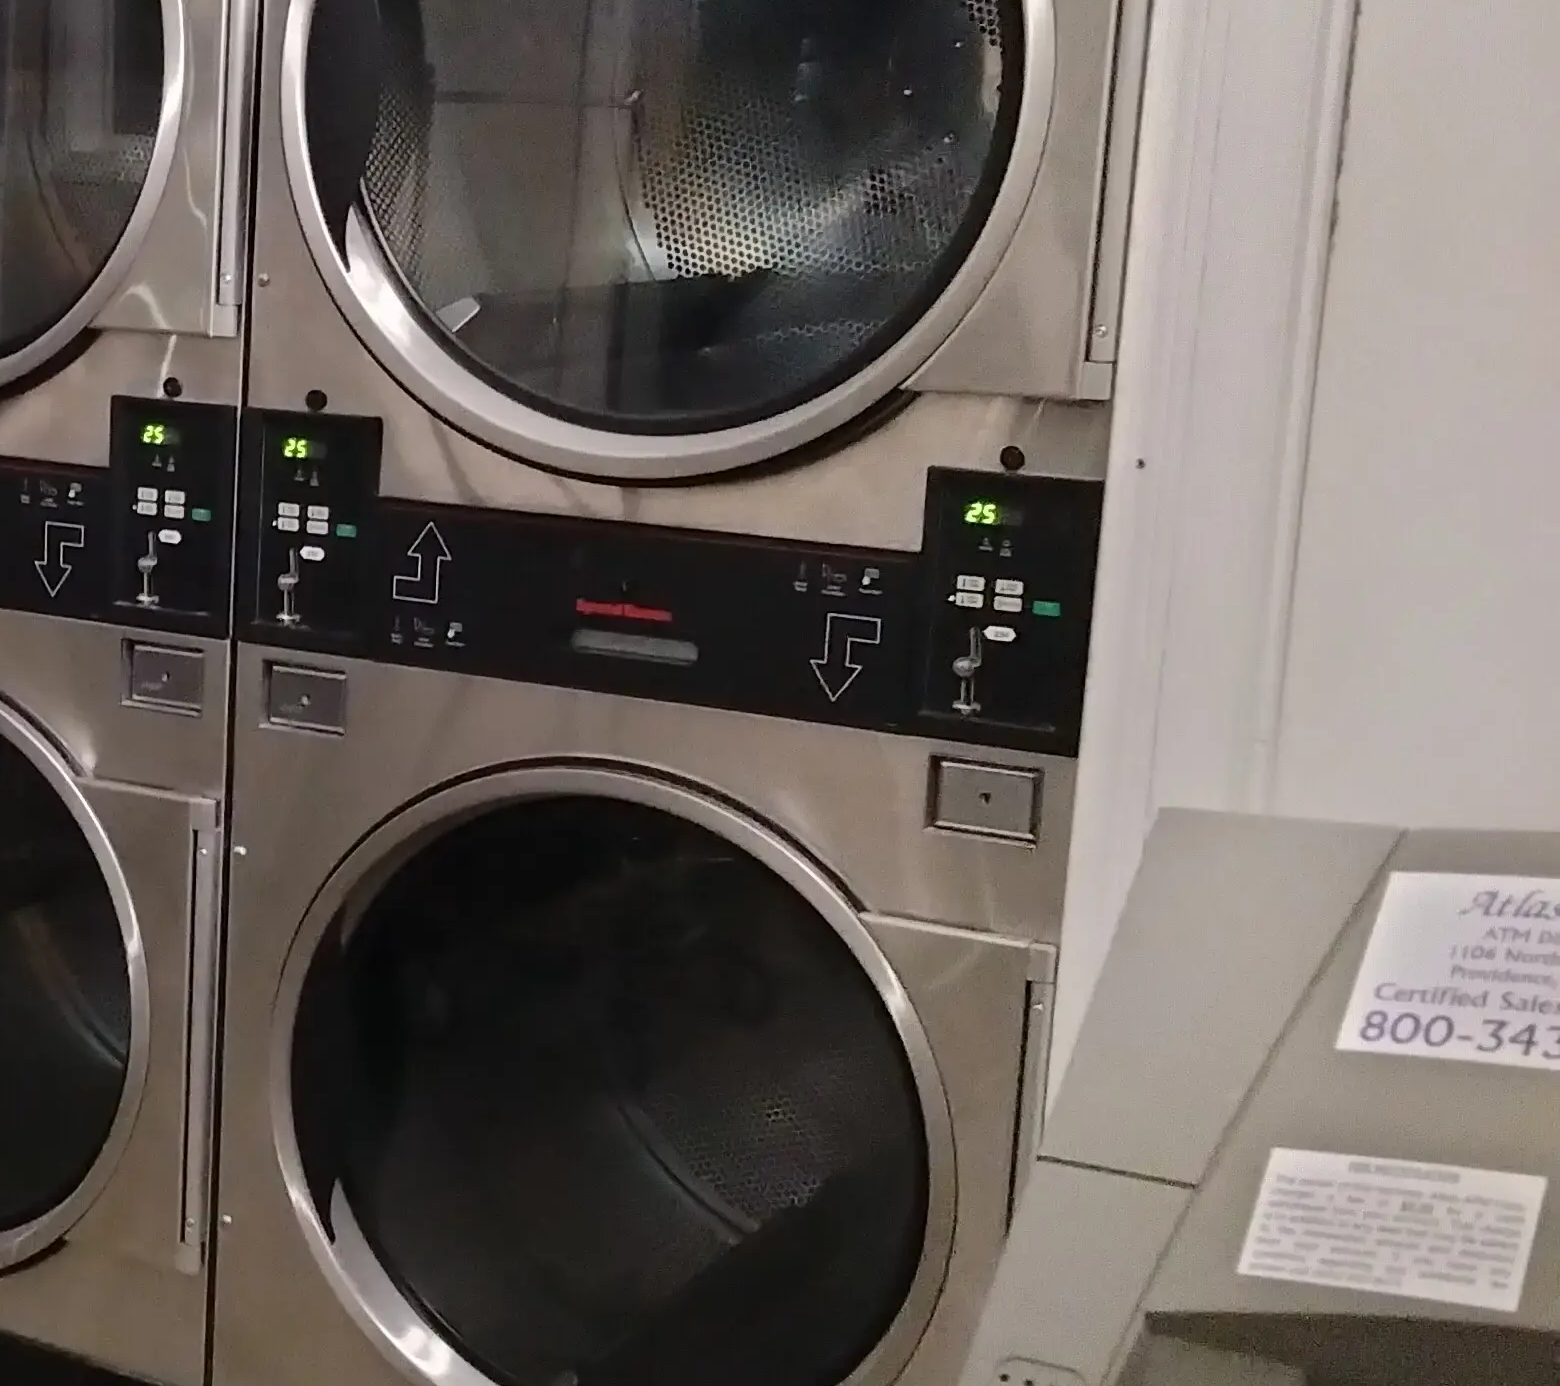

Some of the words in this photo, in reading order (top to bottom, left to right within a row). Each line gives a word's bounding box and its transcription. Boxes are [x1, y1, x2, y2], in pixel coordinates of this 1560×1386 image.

[143, 425, 164, 445] 25
[283, 437, 308, 459] 25
[964, 501, 997, 525] 25
[1482, 926, 1532, 944] ATM
[1374, 981, 1490, 1010] Certified
